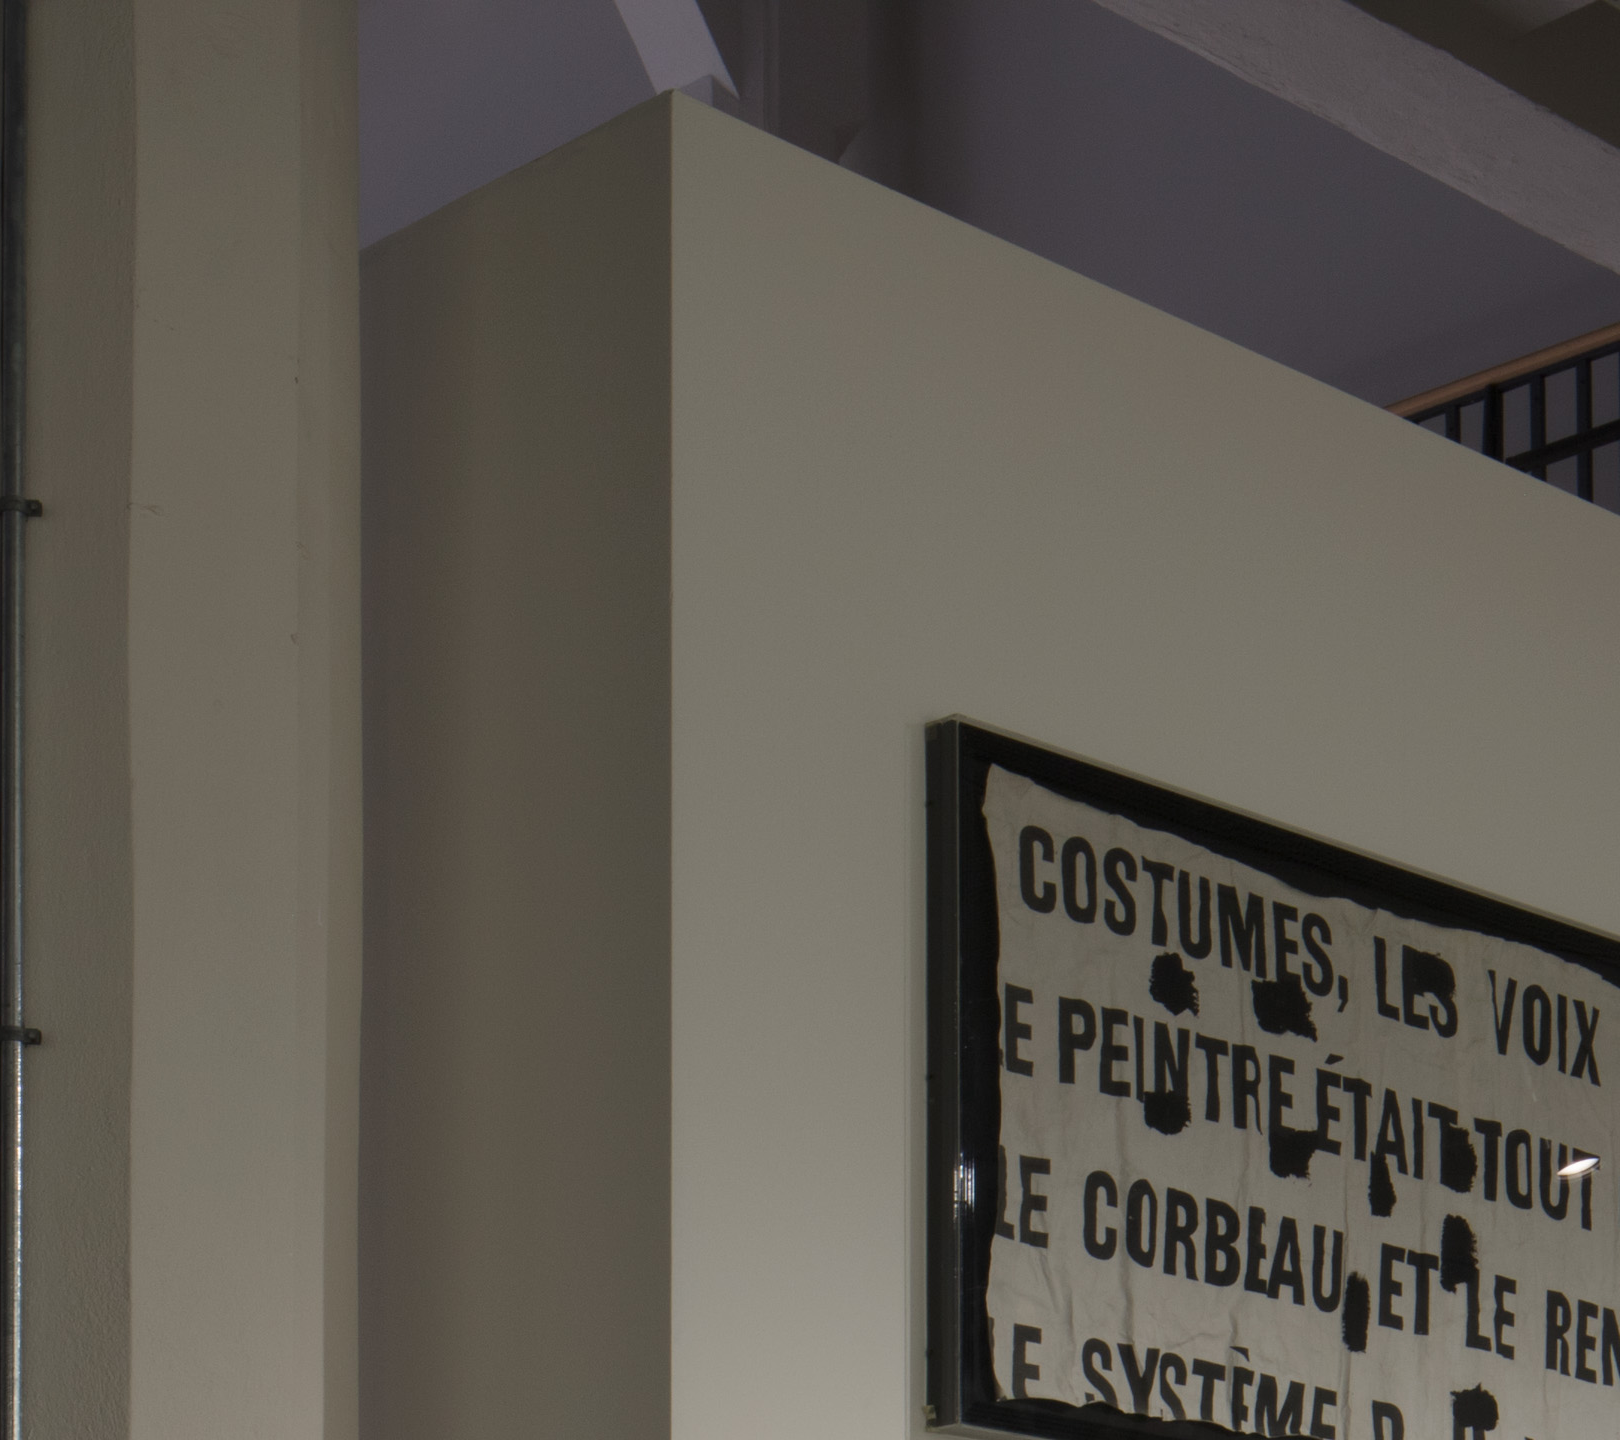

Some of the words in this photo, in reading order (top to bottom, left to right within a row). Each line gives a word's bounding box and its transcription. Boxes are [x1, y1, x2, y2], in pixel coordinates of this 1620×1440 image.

[1018, 825, 1349, 1014] COSTUMES,
[1487, 969, 1601, 1087] VOIX
[1000, 982, 1033, 1077] E
[1058, 996, 1294, 1150] PEINTRE
[1316, 1053, 1458, 1186] ÉTAIT
[1474, 1118, 1600, 1231] TOUT
[1083, 1170, 1343, 1313] CORBEAU
[1378, 1243, 1439, 1336] ET
[1466, 1268, 1516, 1360] LE
